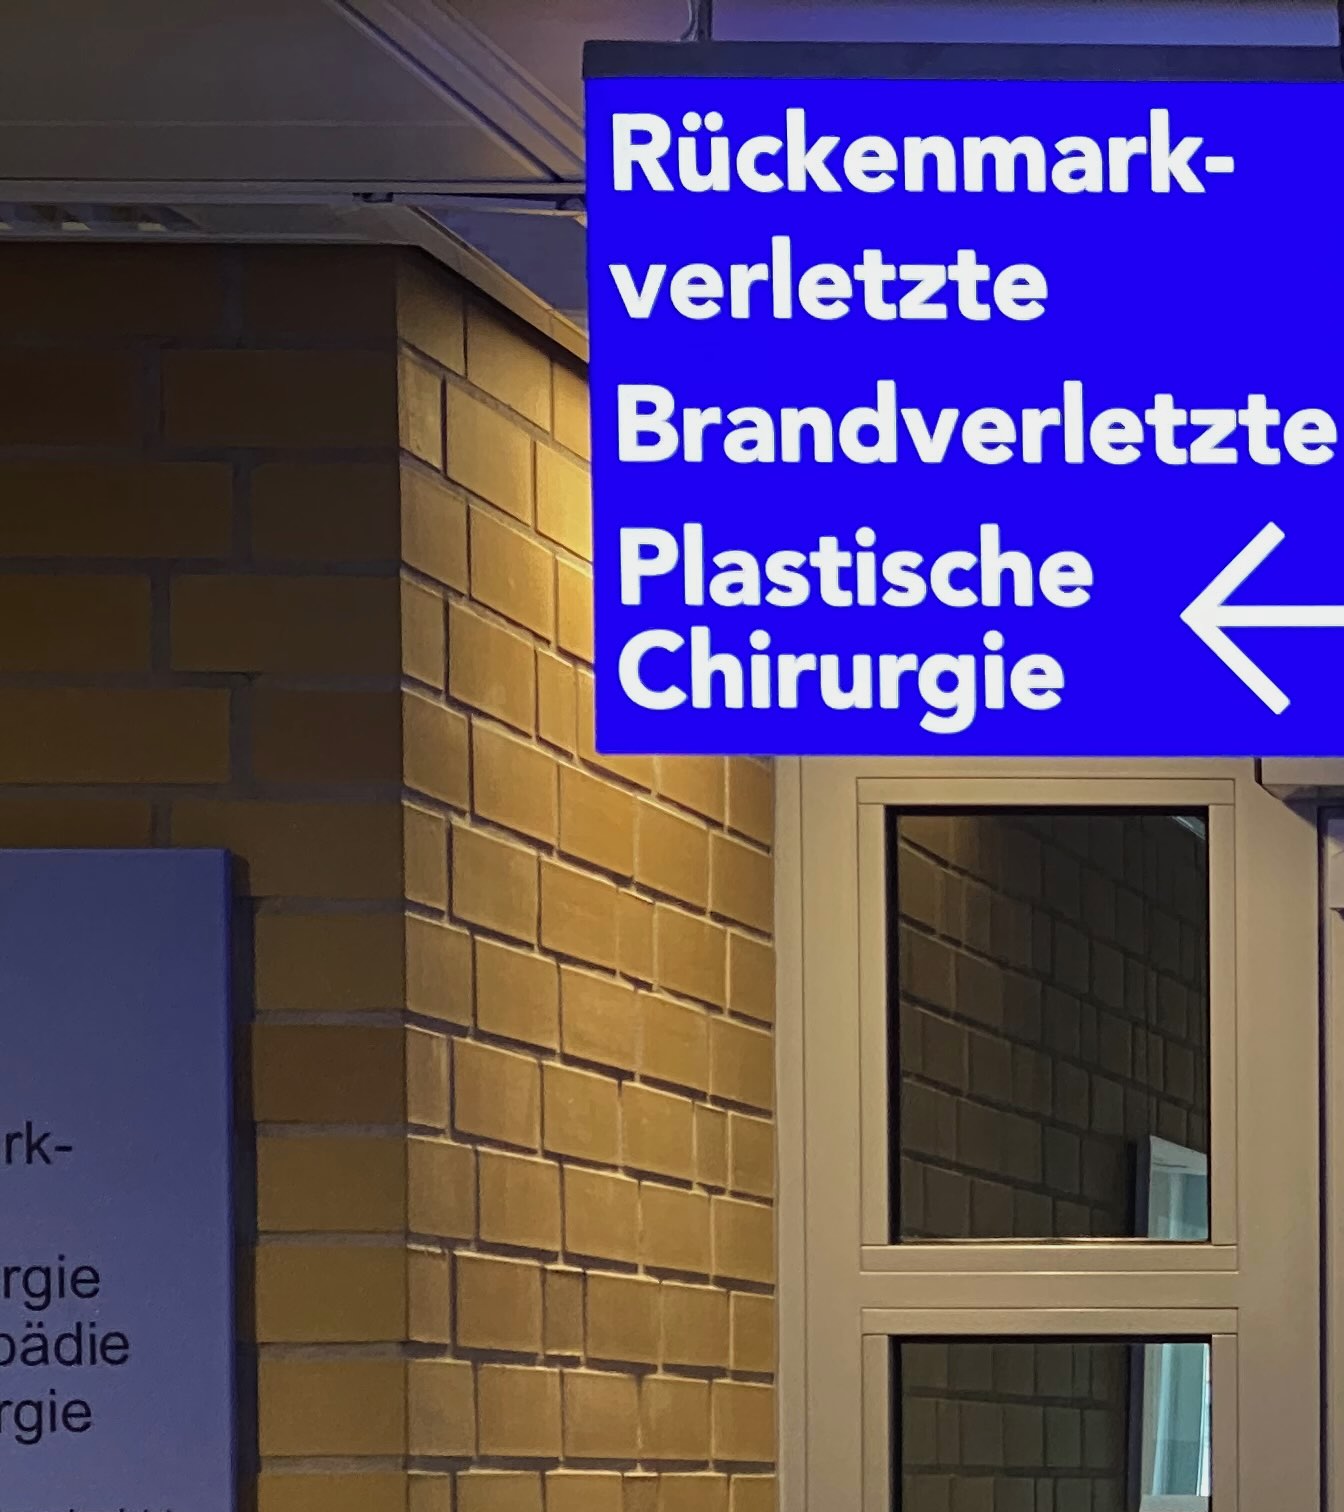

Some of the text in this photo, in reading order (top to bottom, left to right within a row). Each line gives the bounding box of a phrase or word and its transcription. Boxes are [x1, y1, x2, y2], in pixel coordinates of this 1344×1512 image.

[612, 108, 1235, 193] Rückenmark-
[608, 236, 1049, 320] verletzte
[617, 380, 1338, 465] Brandverletzte
[619, 523, 1094, 607] Plastische
[618, 626, 1065, 734] Chirurgie
